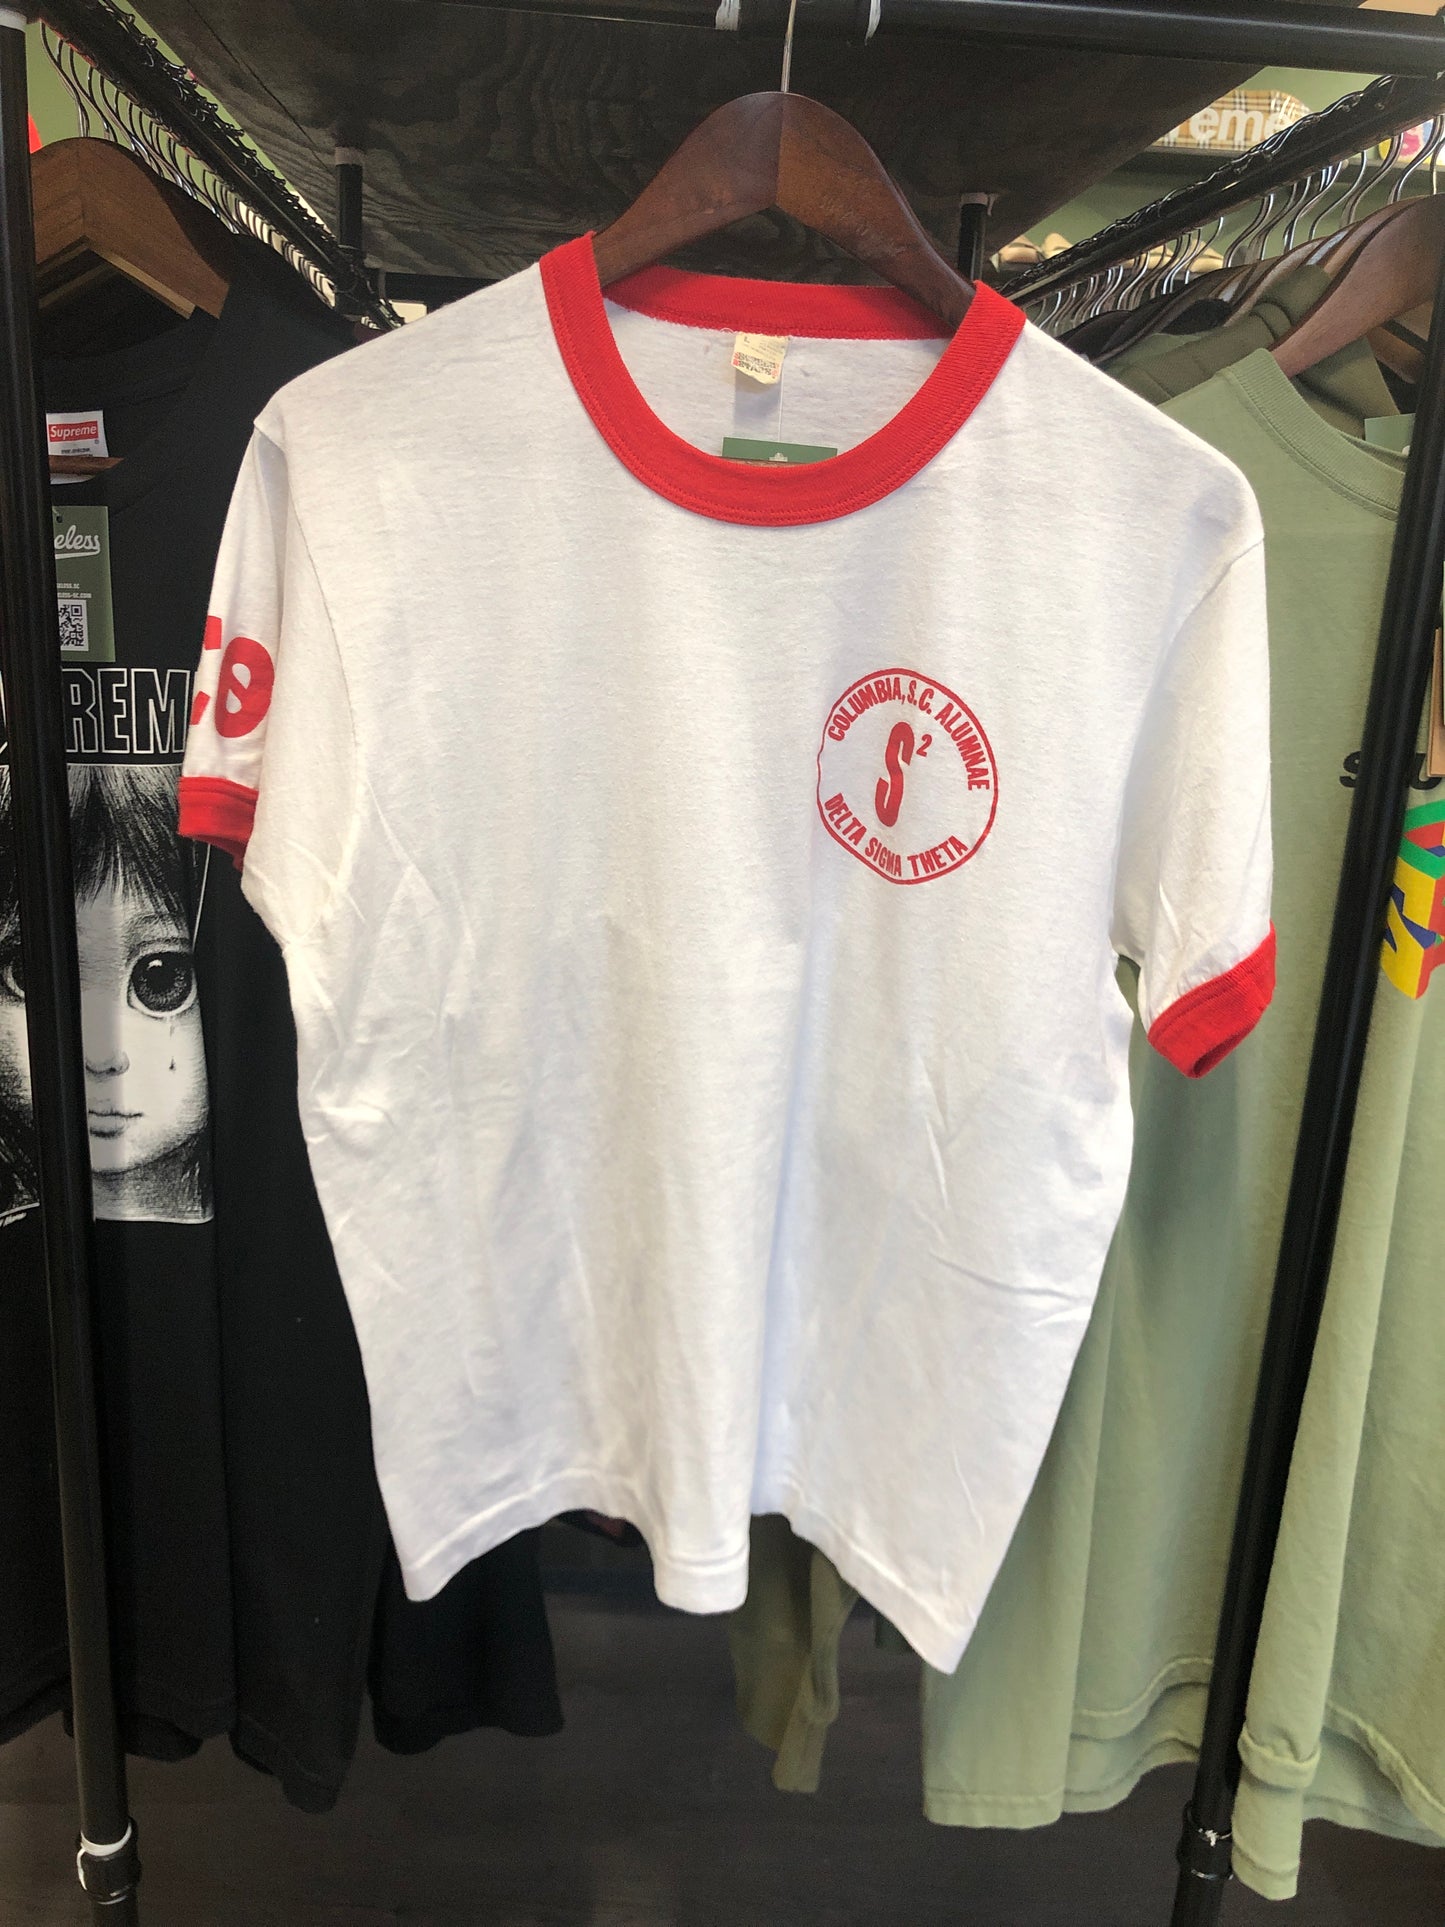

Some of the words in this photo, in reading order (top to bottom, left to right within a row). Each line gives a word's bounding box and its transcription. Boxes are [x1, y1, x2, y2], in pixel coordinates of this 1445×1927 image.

[50, 425, 97, 441] Supreme
[934, 702, 990, 791] ALUMNAE
[824, 792, 867, 847] DELTA
[864, 837, 902, 877] SIGMA
[907, 835, 969, 877] THETA
